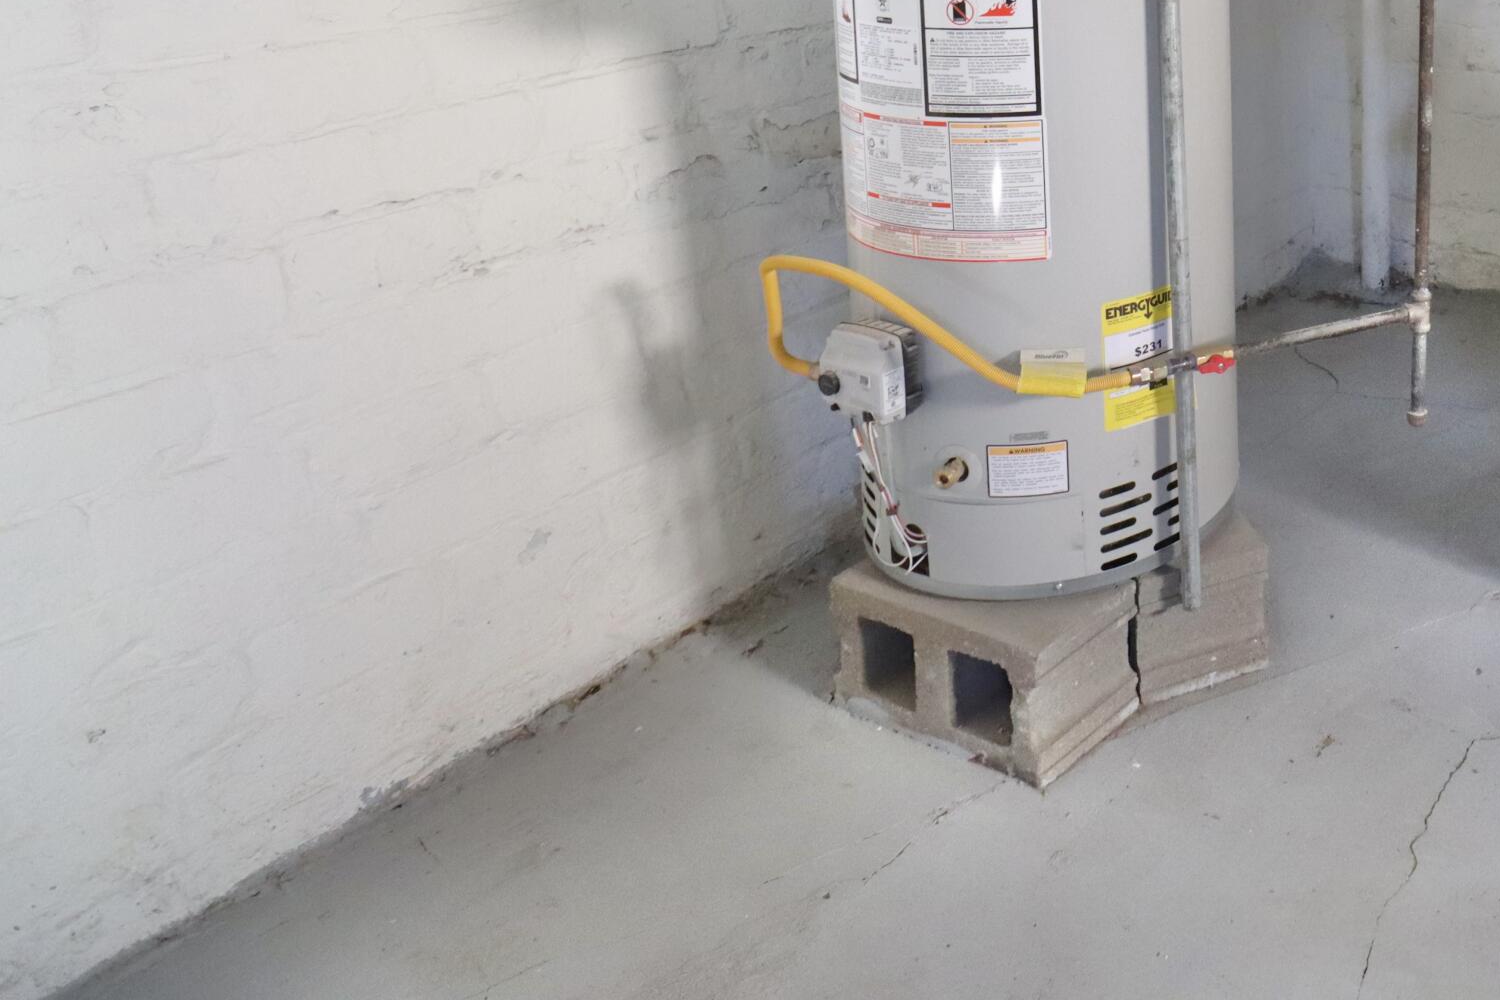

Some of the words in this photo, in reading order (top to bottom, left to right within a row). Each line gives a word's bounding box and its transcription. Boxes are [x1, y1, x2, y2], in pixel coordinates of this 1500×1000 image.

[1105, 290, 1172, 321] ENERGYGUI
[1134, 338, 1163, 357] $231
[1014, 446, 1046, 455] WARNING
